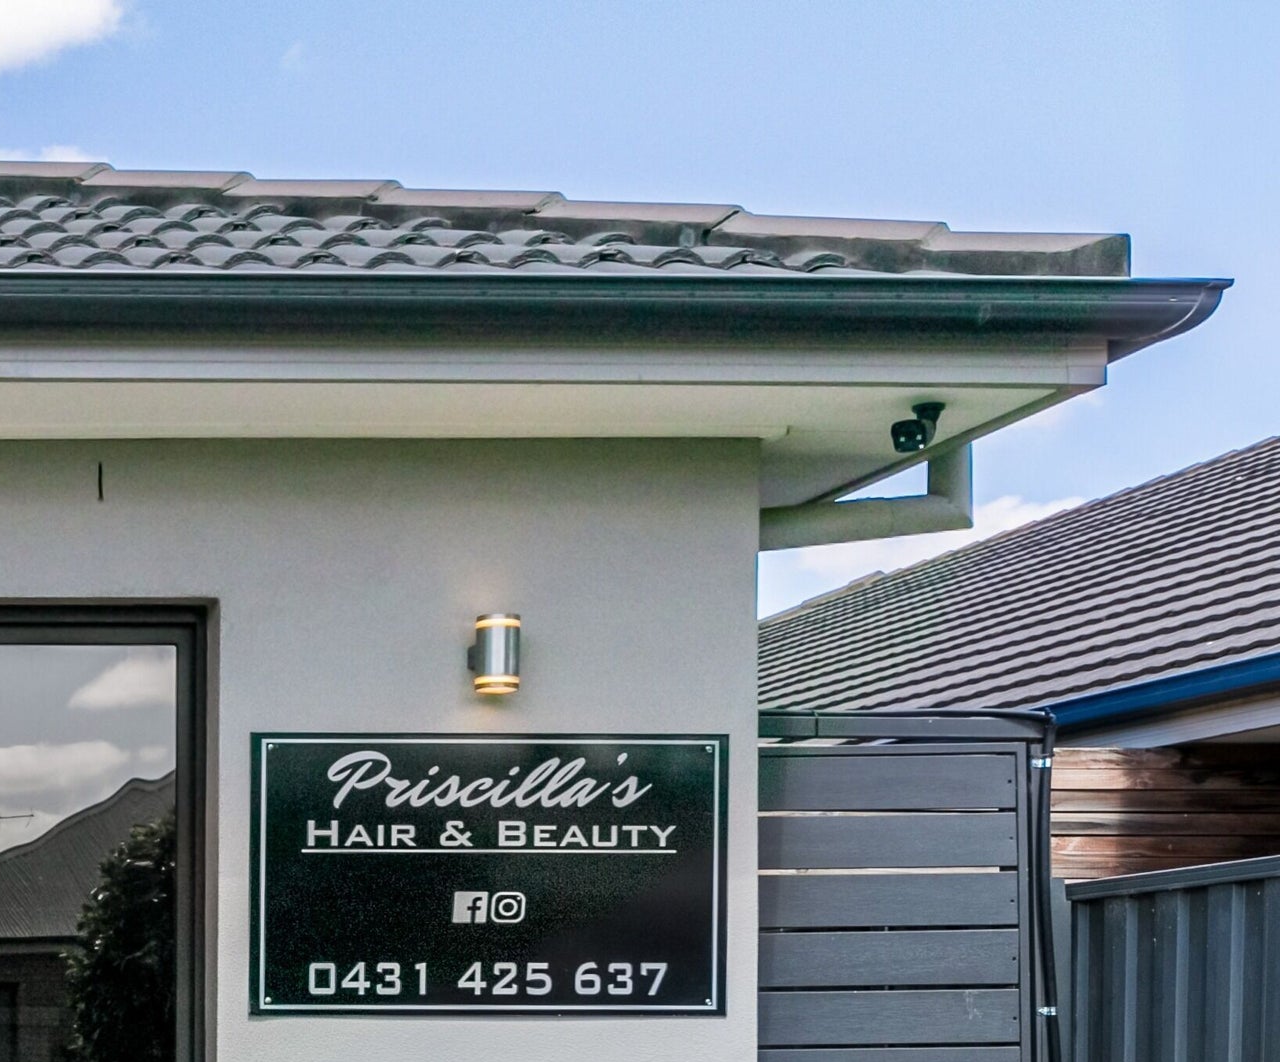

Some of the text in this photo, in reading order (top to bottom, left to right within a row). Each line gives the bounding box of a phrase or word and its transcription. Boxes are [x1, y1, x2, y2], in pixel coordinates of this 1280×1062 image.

[327, 750, 653, 809] Priscilla's
[439, 820, 474, 848] &
[308, 961, 668, 996] 0431 425 637
